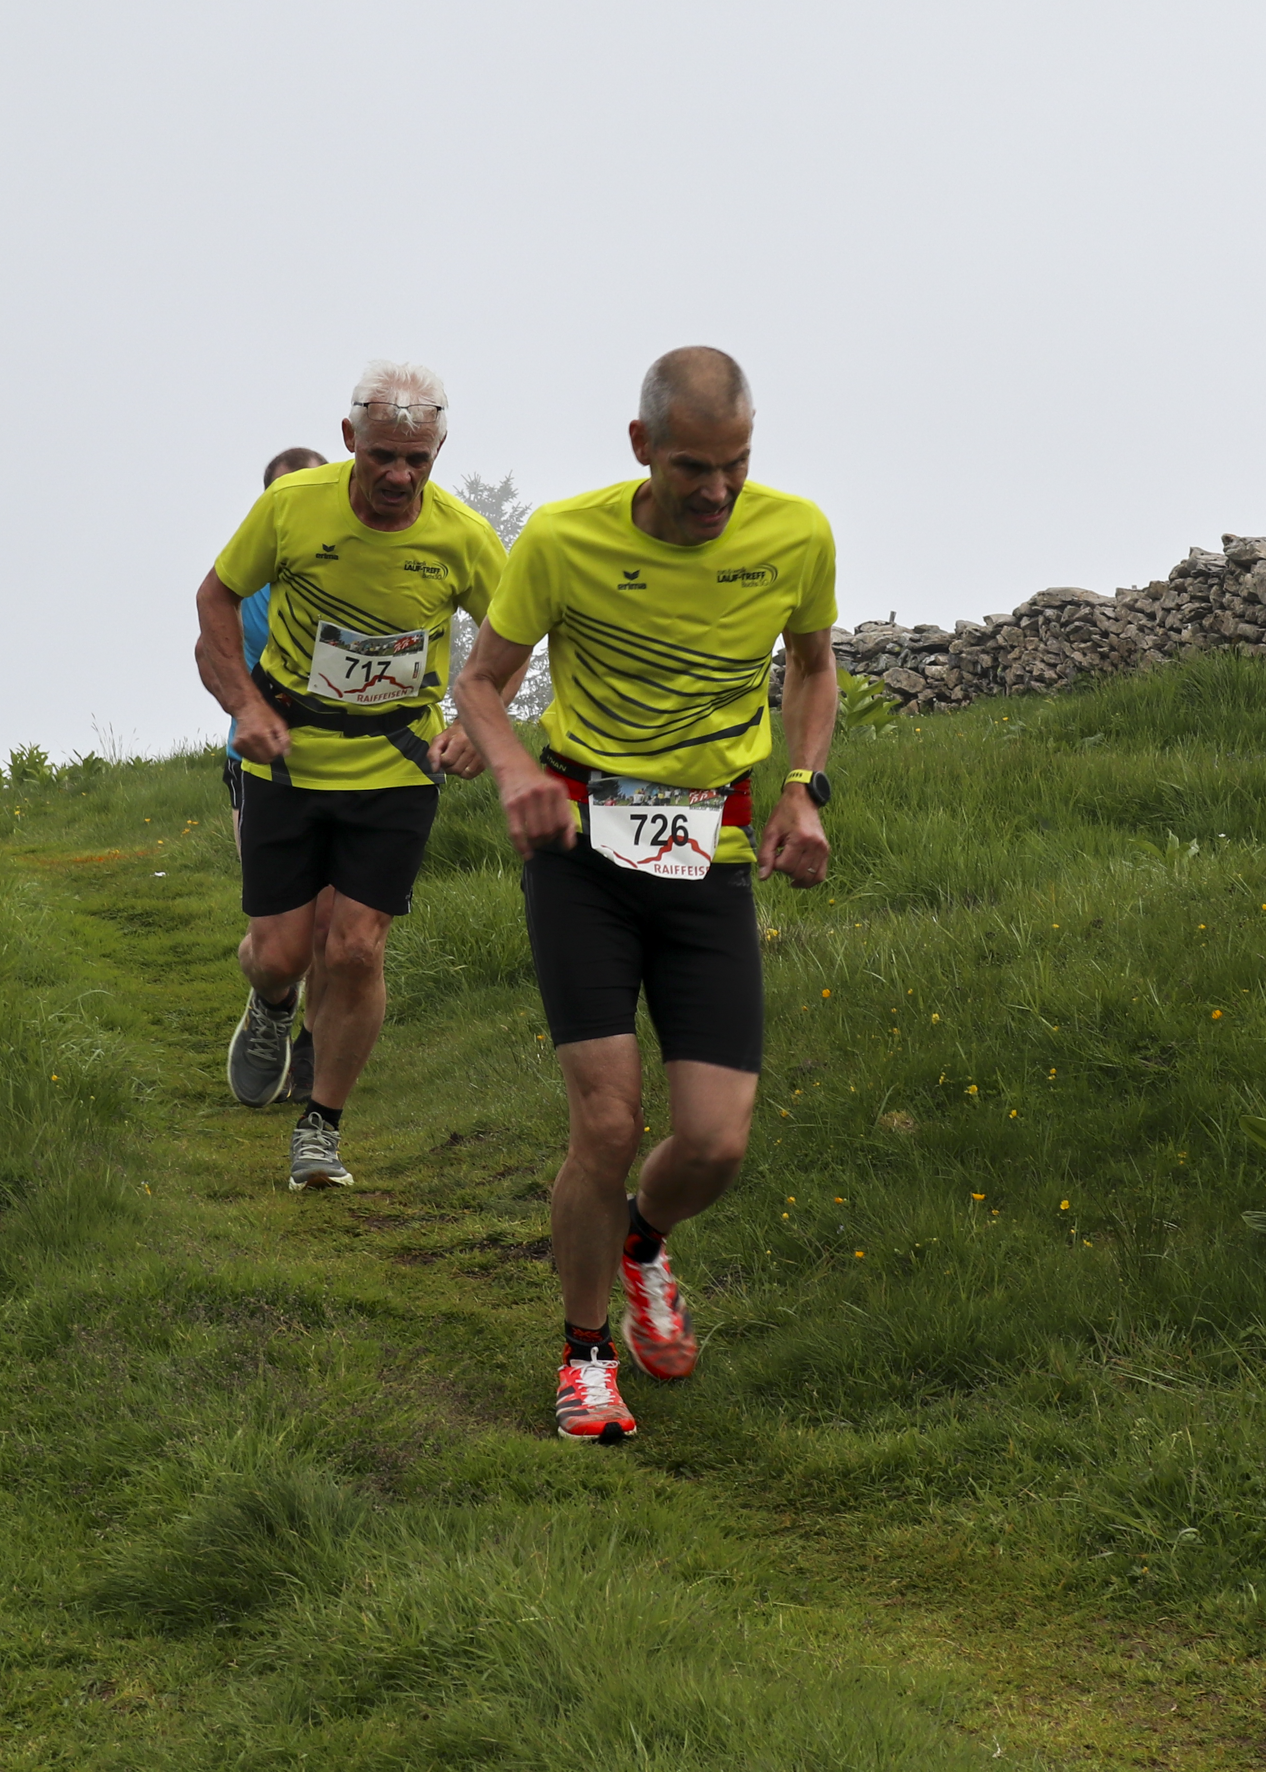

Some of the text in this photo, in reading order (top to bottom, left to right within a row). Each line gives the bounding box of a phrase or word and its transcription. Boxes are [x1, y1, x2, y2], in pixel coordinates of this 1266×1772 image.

[345, 656, 392, 683] 717
[356, 689, 408, 703] RAIFFEISEN
[629, 813, 690, 847] 726
